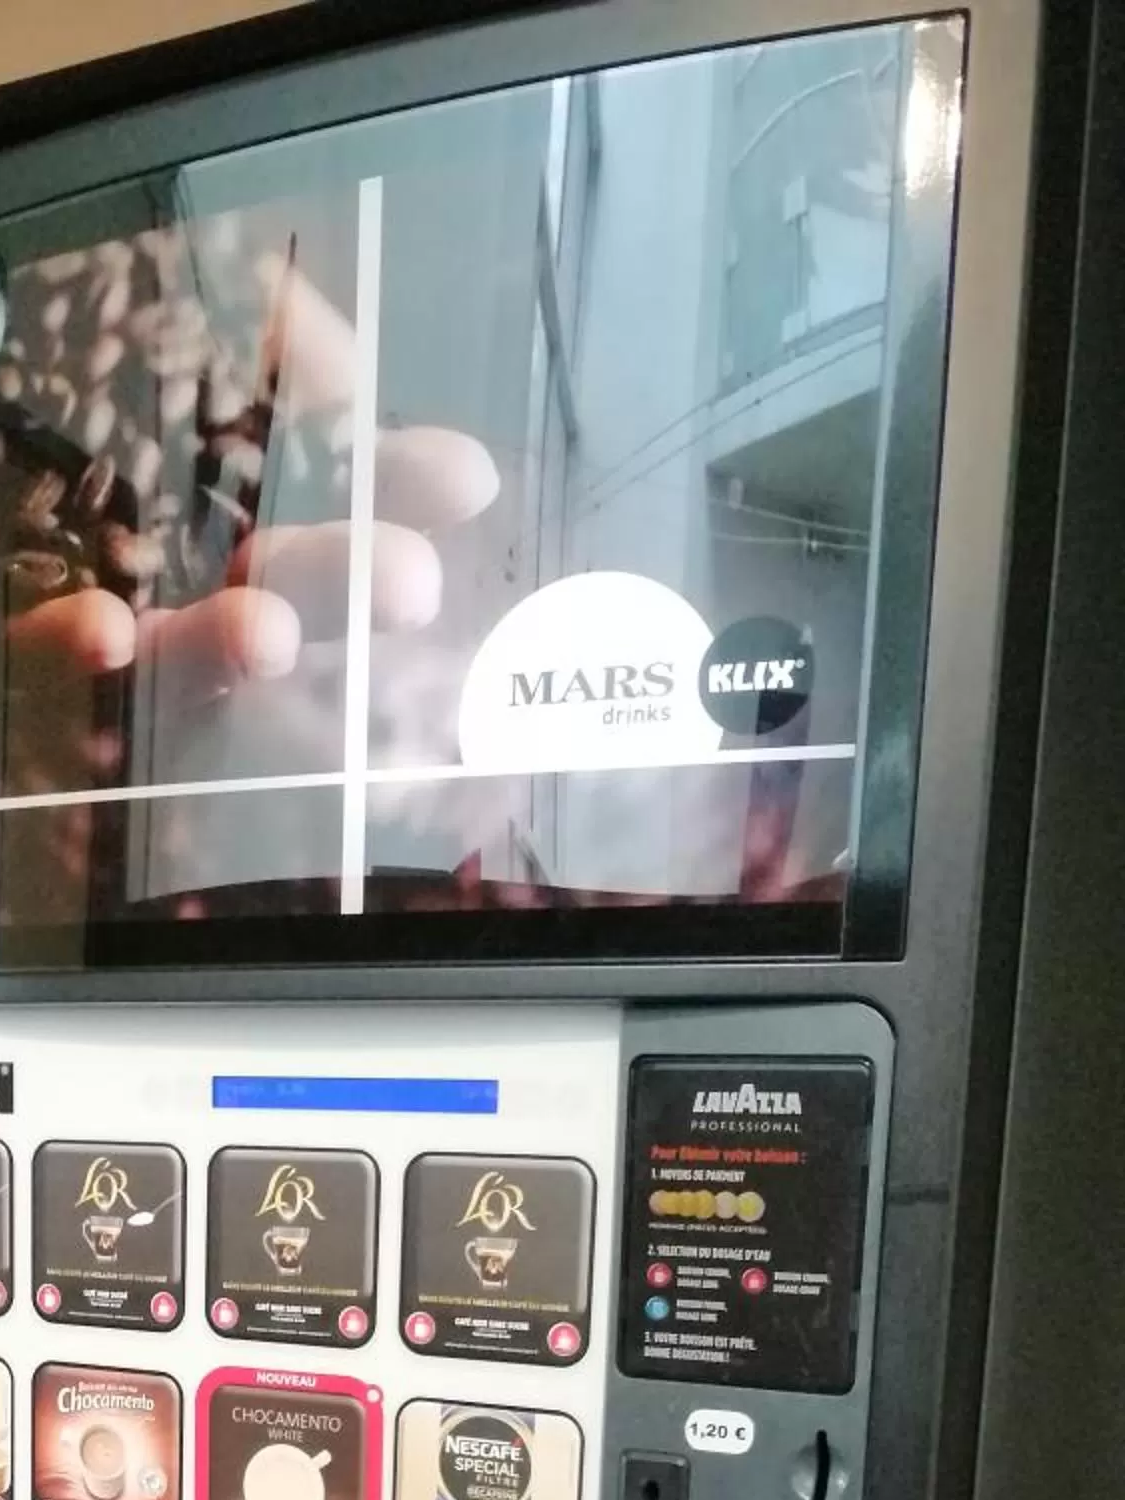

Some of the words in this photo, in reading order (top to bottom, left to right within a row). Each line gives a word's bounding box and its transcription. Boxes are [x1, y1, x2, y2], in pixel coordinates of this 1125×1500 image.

[508, 662, 674, 707] MARS
[602, 703, 672, 727] drinks
[692, 1084, 802, 1115] LAVAZZA
[690, 1120, 802, 1133] PROFESSIONAL
[256, 1371, 316, 1388] NOUVEAU
[232, 1407, 342, 1433] CHOCAMENTO
[267, 1428, 304, 1442] WHITE
[689, 1423, 728, 1439] 1,20
[735, 1426, 747, 1441] €
